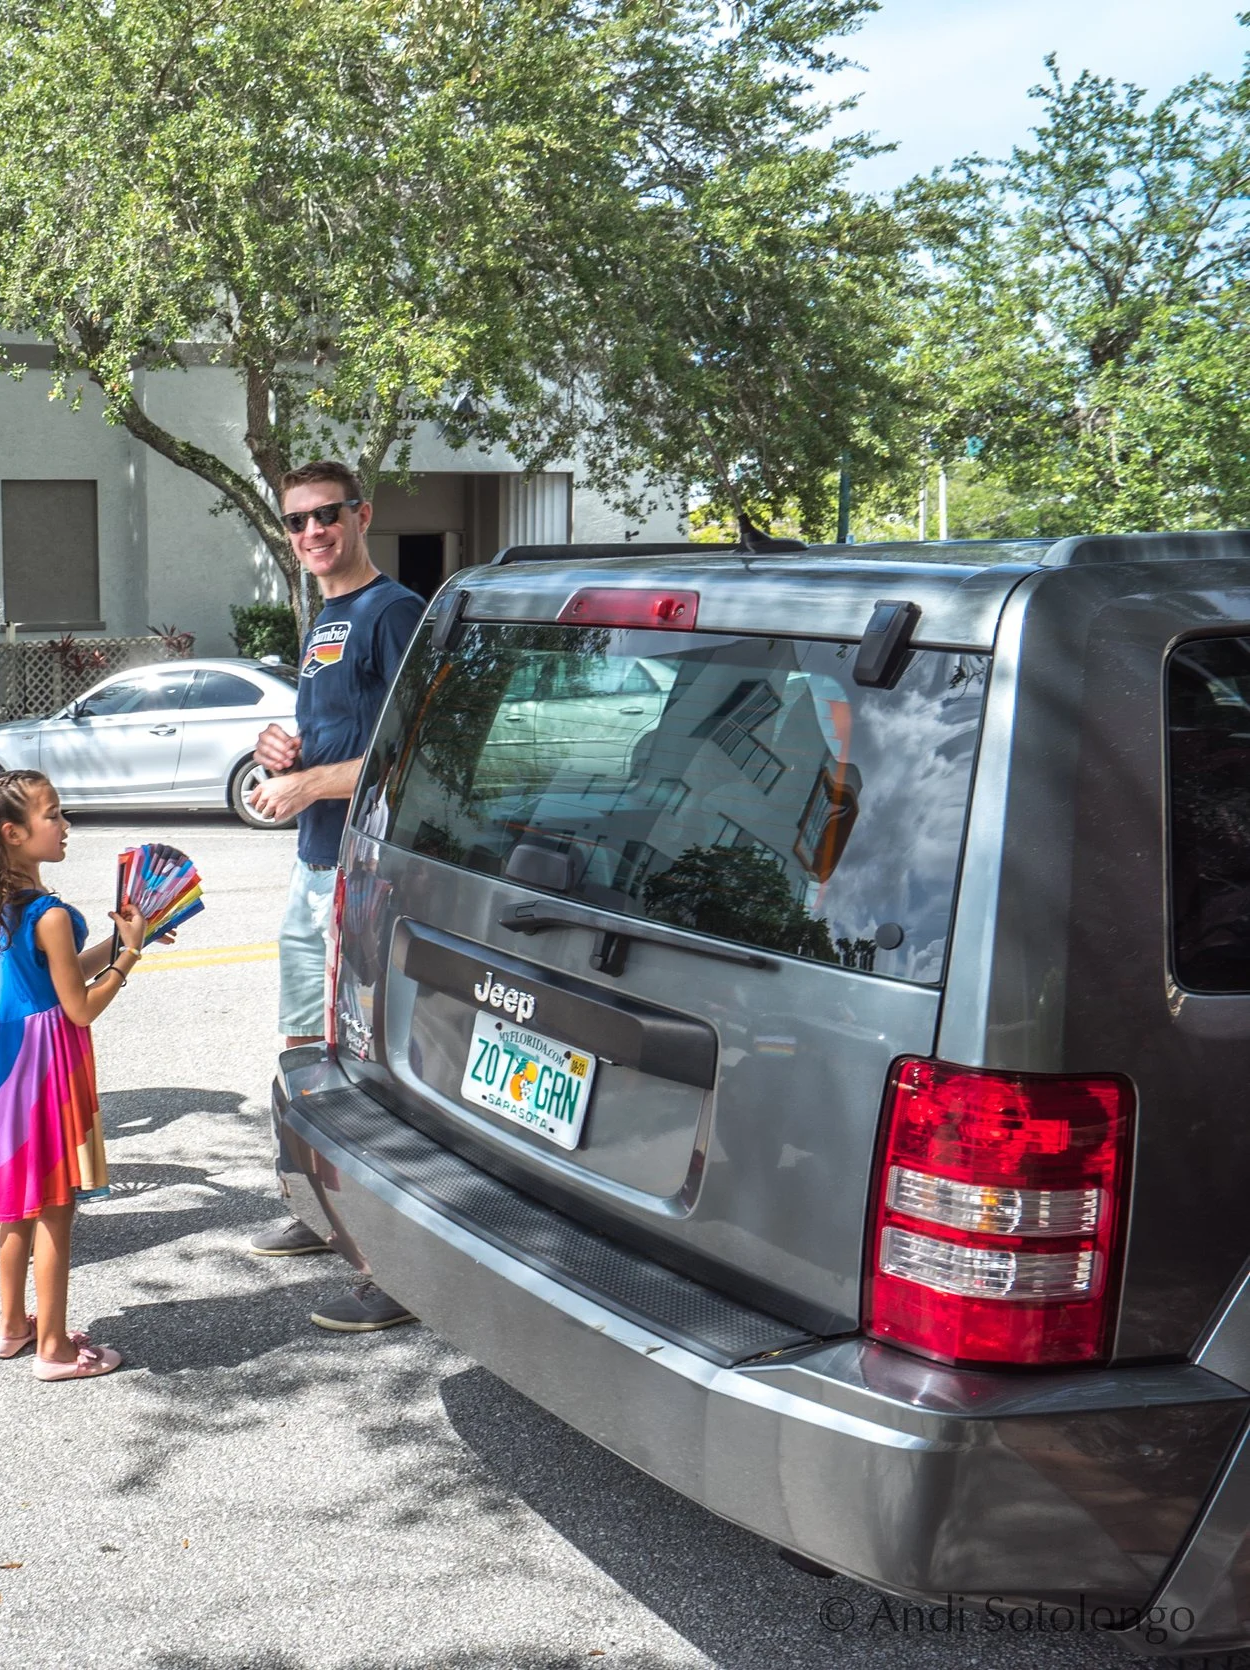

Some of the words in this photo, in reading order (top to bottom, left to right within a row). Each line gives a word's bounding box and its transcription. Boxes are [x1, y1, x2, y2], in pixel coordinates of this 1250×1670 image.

[311, 626, 347, 643] lumbia
[474, 972, 536, 1023] Jeep
[488, 1093, 548, 1131] SARASOTA
[534, 1065, 582, 1125] GRN
